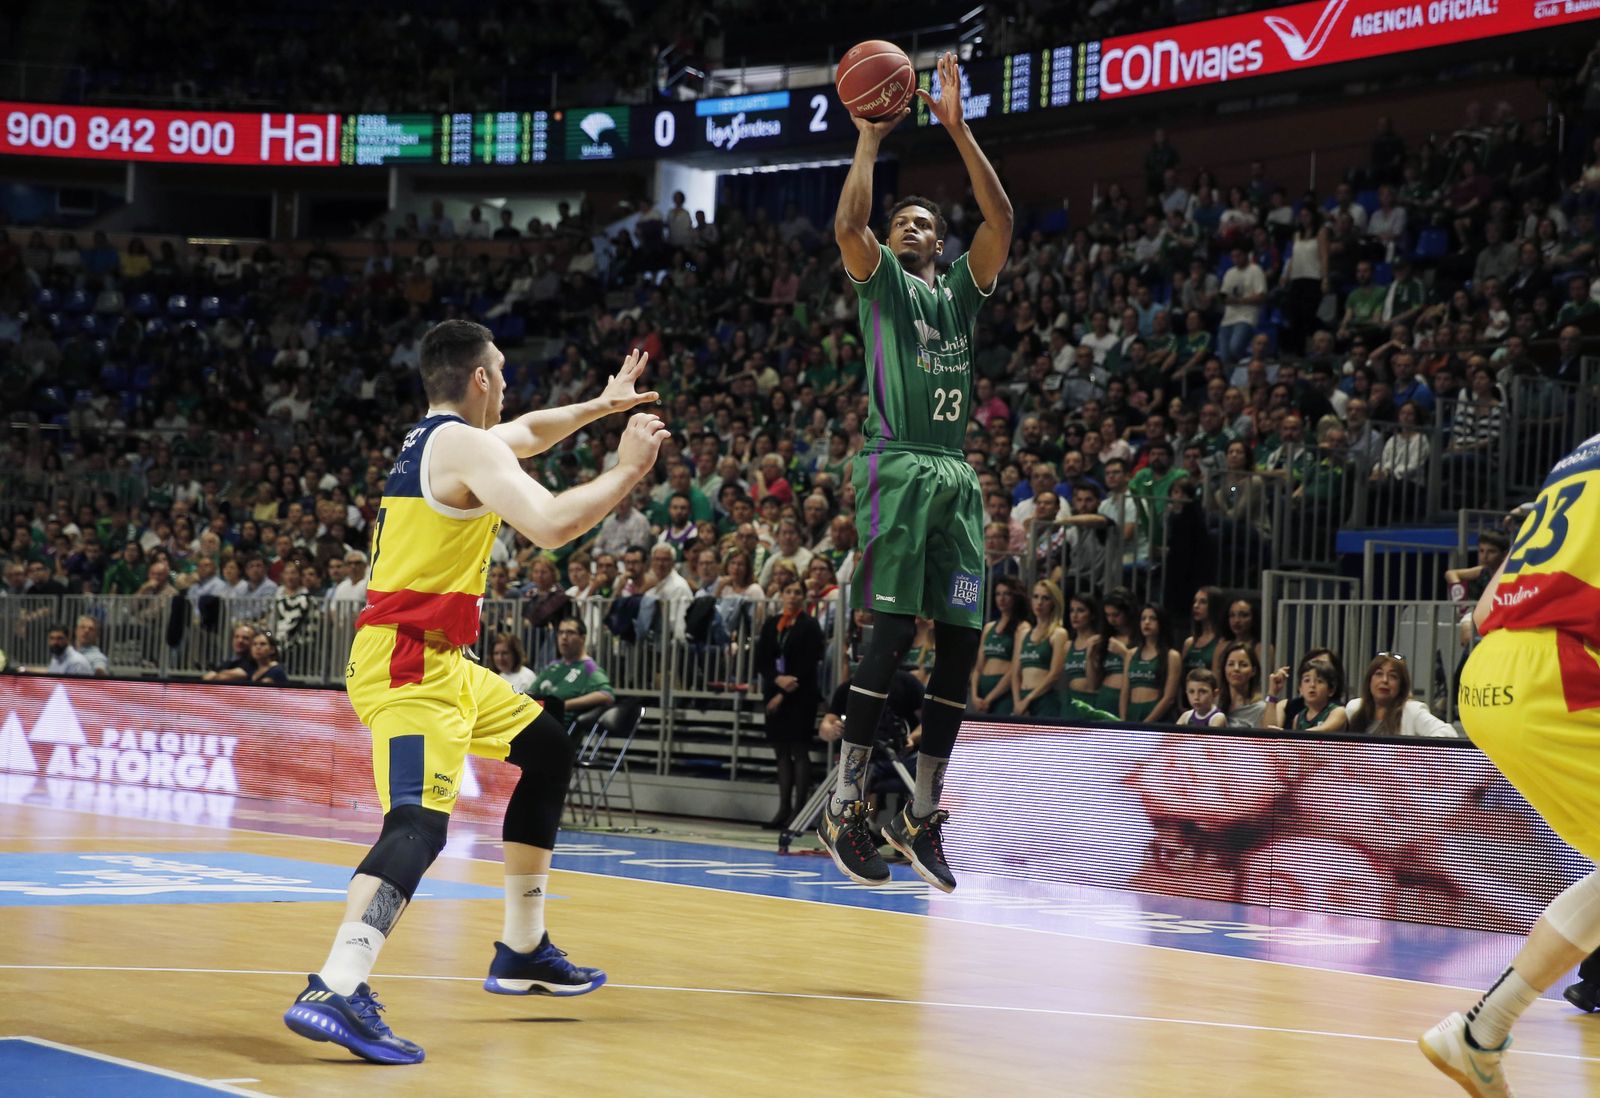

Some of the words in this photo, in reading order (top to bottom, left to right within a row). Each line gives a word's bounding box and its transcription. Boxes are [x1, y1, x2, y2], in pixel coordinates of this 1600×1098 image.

[1350, 5, 1424, 38] AGENCIA
[654, 110, 676, 147] 0
[809, 94, 828, 133] 2
[7, 111, 76, 149] 900
[87, 116, 155, 153] 842
[168, 120, 235, 156] 900
[260, 113, 336, 162] Hal
[933, 387, 963, 421] 23
[1503, 481, 1587, 574] 23
[102, 727, 240, 757] PARQUET
[46, 746, 239, 794] ASTORGA
